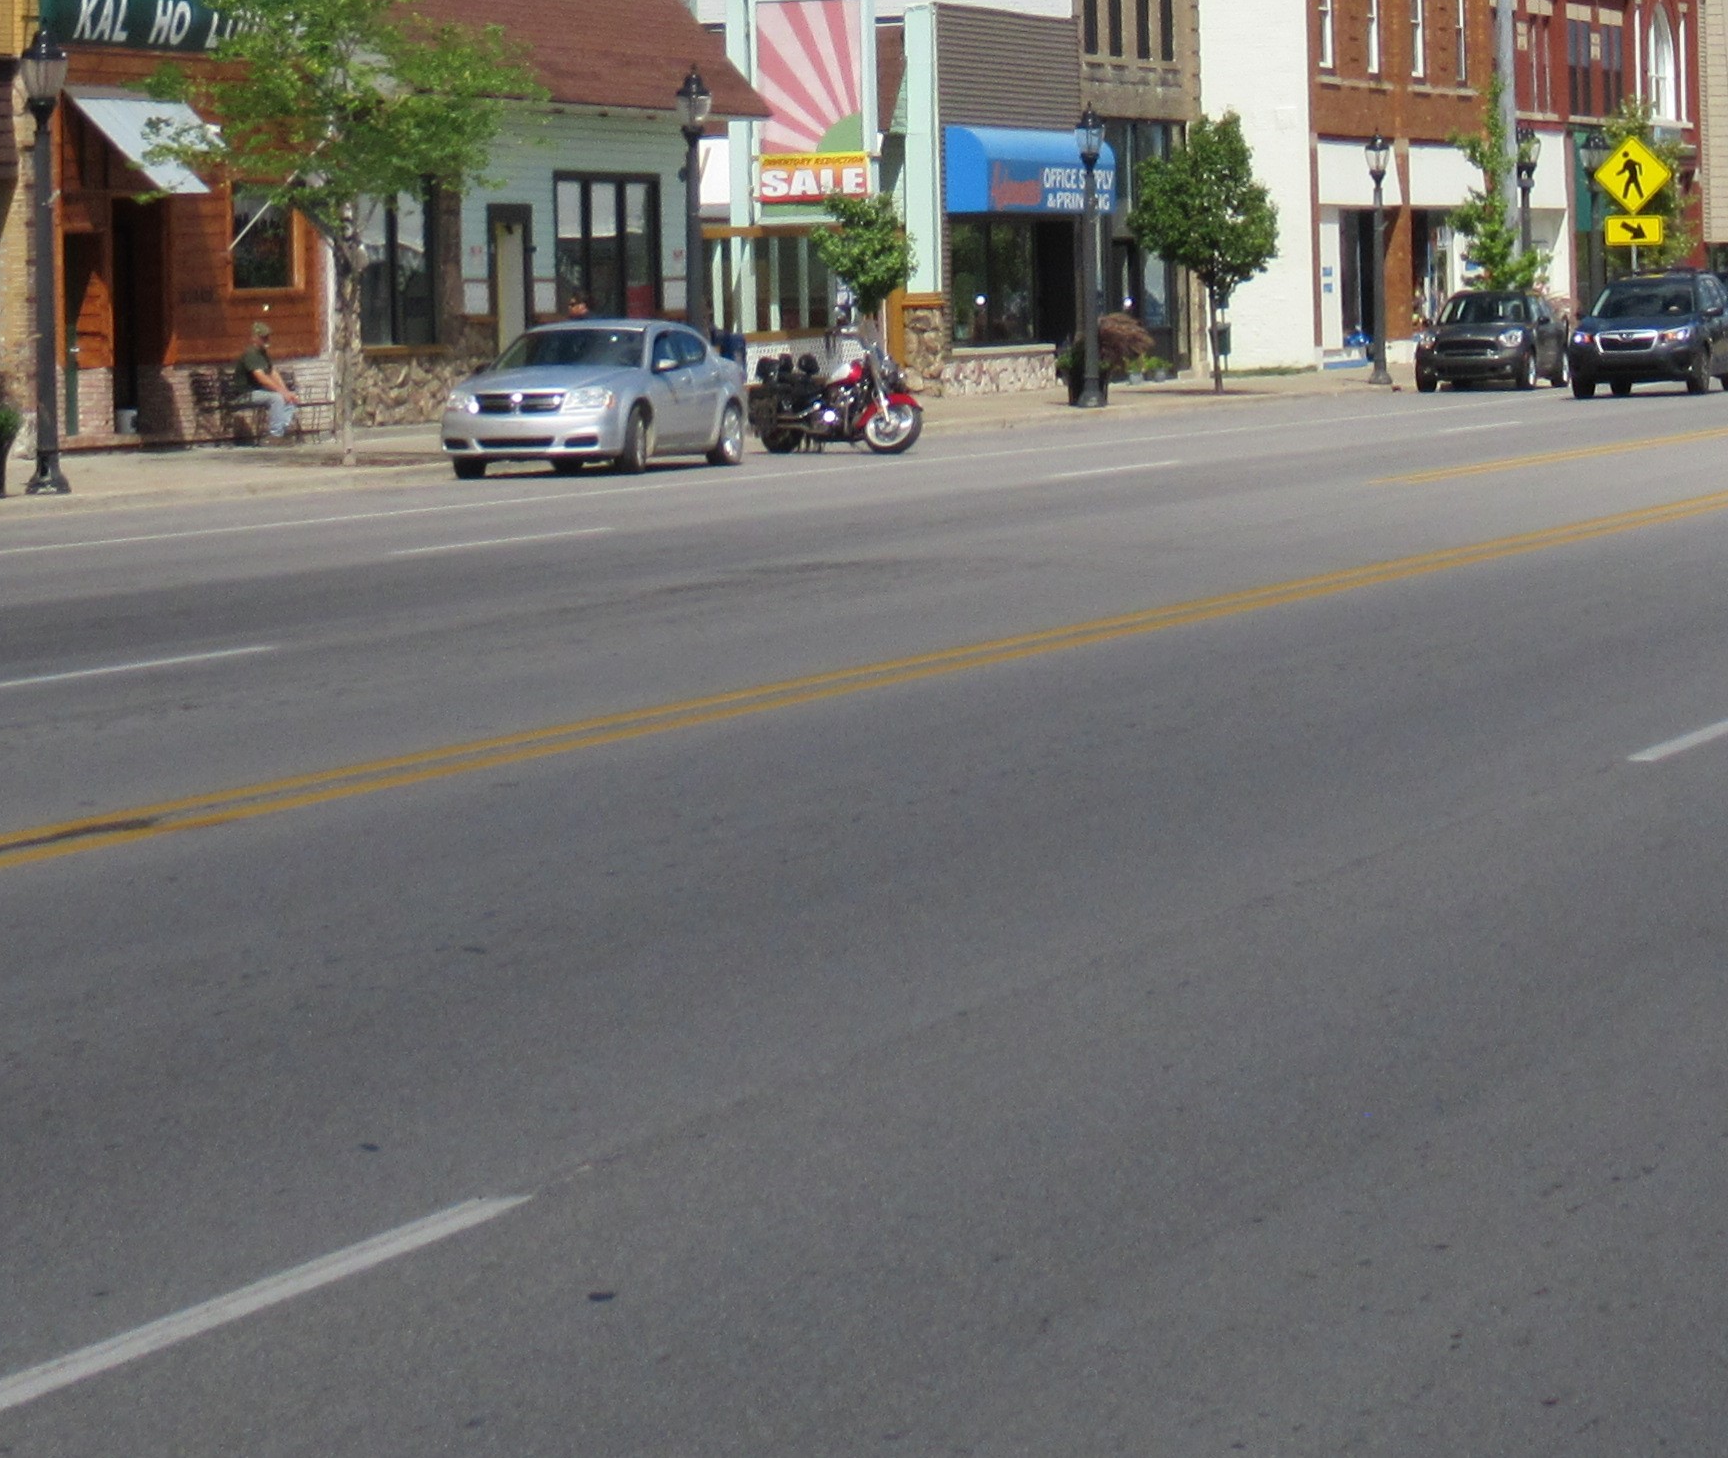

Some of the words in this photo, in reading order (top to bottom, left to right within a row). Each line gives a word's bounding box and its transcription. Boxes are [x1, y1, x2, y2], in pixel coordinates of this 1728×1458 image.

[761, 167, 865, 197] SALE
[1043, 168, 1077, 189] OFFICE
[1079, 168, 1114, 190] SPLY
